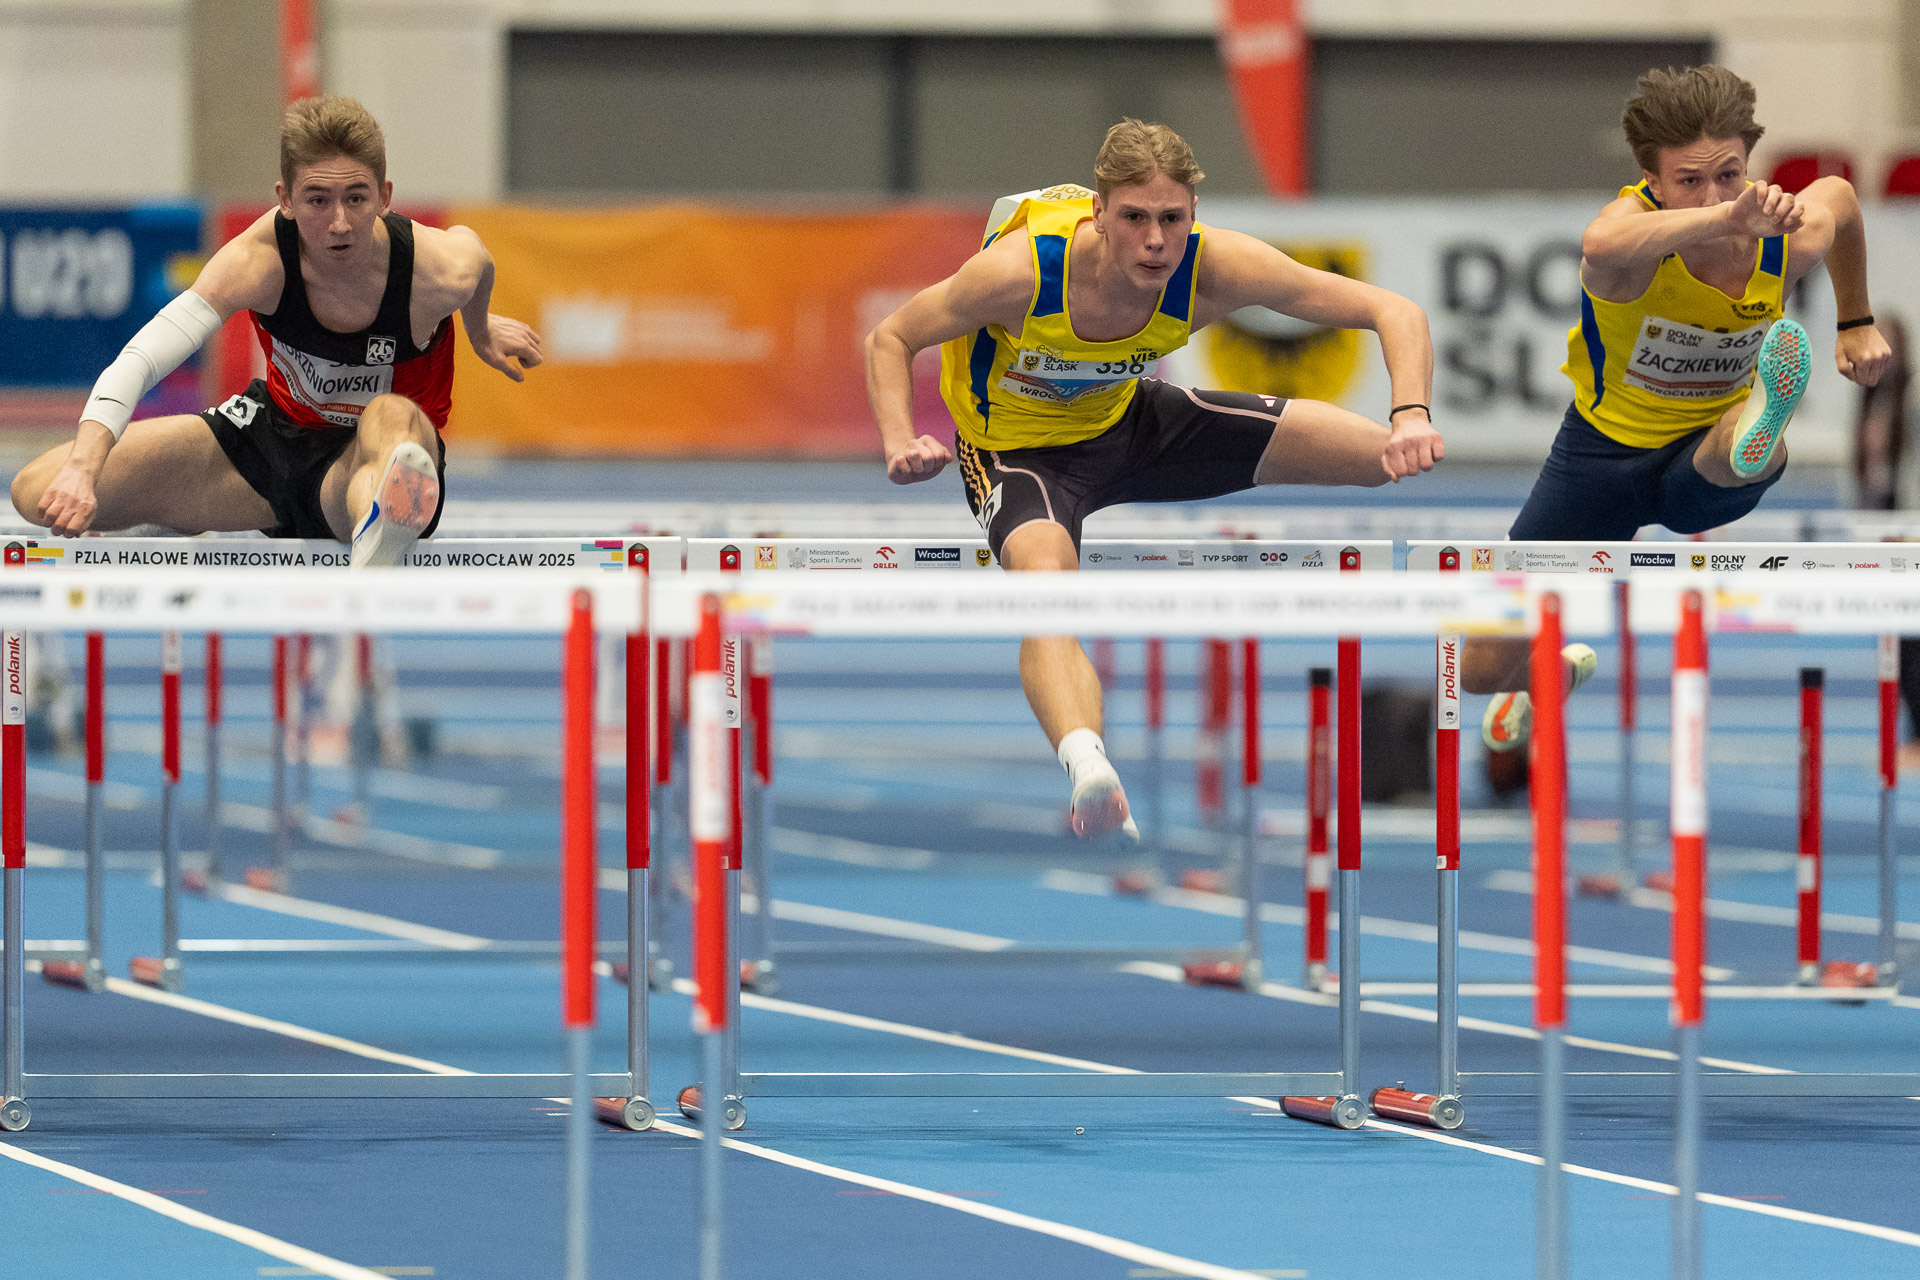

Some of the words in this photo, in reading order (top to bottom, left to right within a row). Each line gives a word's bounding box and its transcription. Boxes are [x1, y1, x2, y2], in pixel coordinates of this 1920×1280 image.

[1667, 329, 1704, 342] DOLNY
[809, 549, 850, 557] Ministerstwo
[917, 549, 958, 559] Wrocław
[1525, 552, 1566, 560] Ministerstwo
[75, 551, 111, 564] PZLA
[118, 551, 189, 565] HALOWE
[193, 552, 306, 566] MISTRZOSTWA
[312, 553, 351, 566] POLS
[413, 554, 442, 566] U20
[446, 554, 533, 567] WROCŁAW
[538, 554, 576, 567] 2025
[835, 556, 863, 564] Turystyki
[1551, 560, 1579, 568] Turystyki
[1633, 554, 1673, 564] Wrocław
[1711, 555, 1746, 563] DOLNY
[7, 636, 22, 695] polanik
[724, 640, 738, 698] polanik
[1442, 641, 1457, 700] polanik
